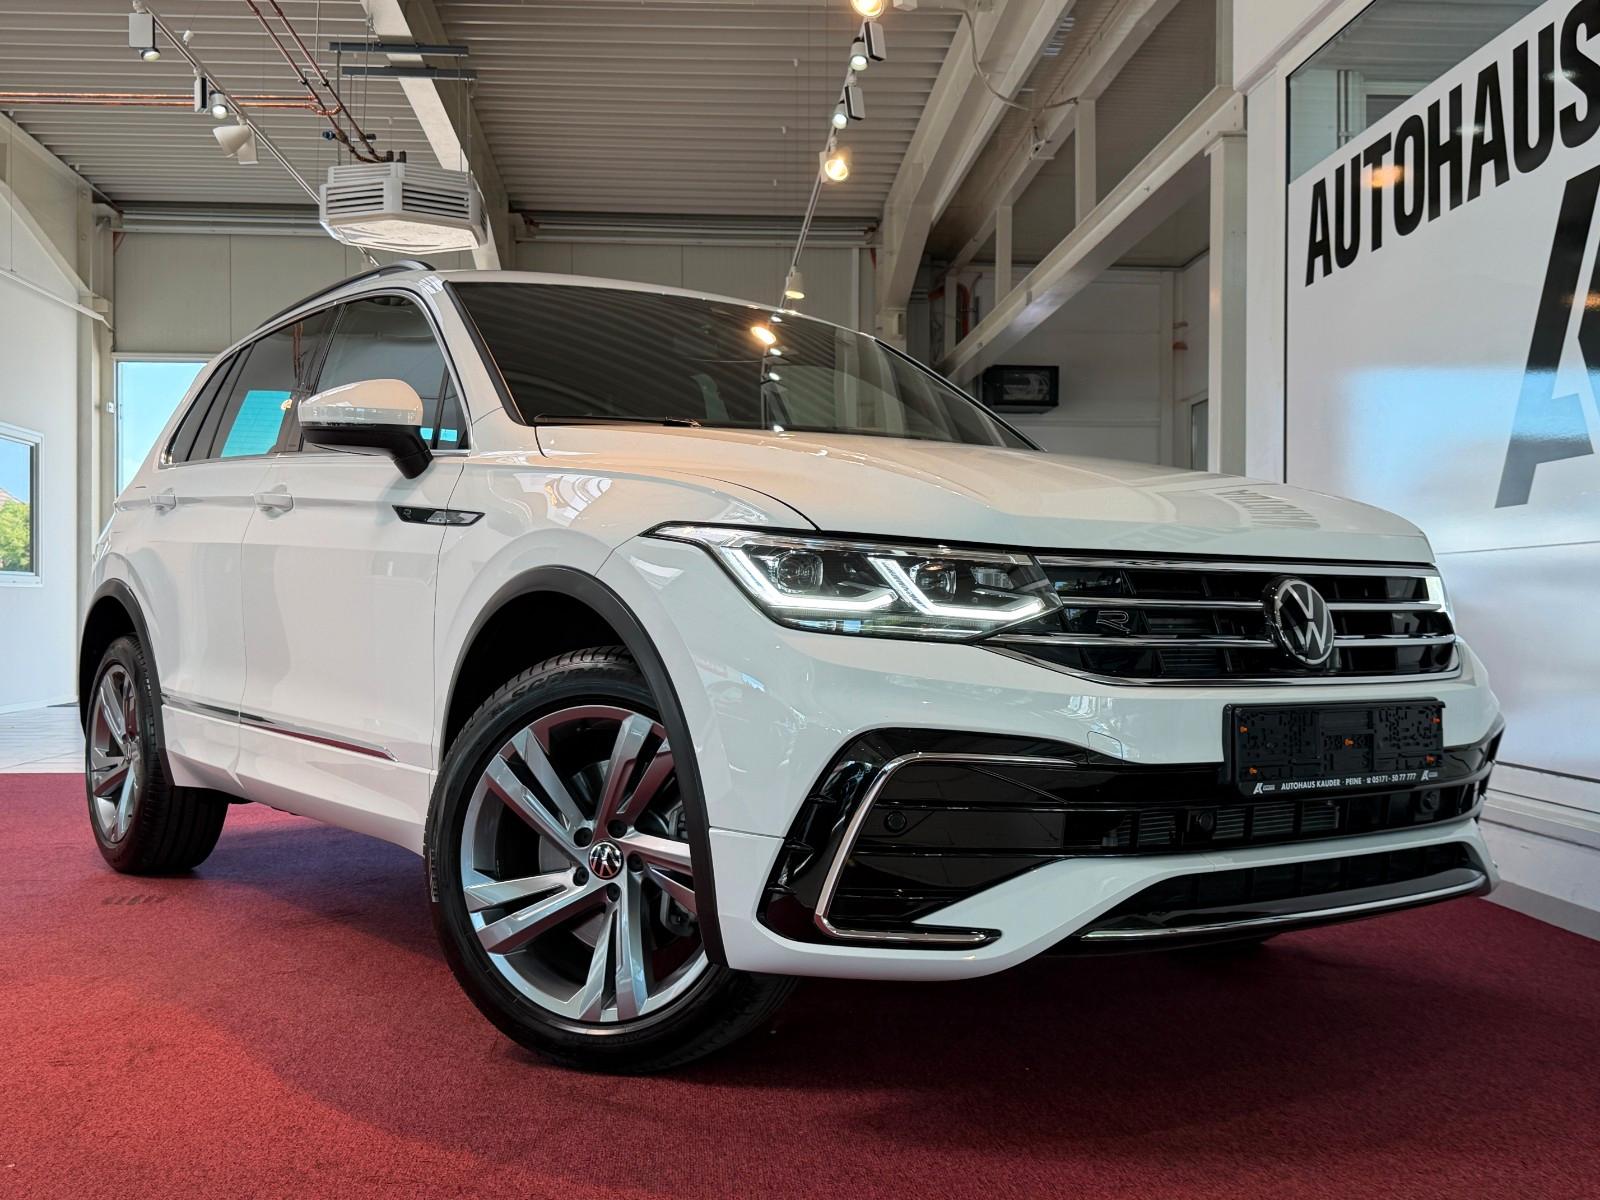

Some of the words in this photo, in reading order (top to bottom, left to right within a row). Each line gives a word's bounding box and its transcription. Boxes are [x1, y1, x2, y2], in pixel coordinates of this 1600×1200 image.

[1305, 0, 1600, 287] AUTOHAUS
[1280, 781, 1315, 790] AUTOHAUS
[1316, 778, 1341, 788] KAUDER
[1345, 777, 1362, 786] PEINE
